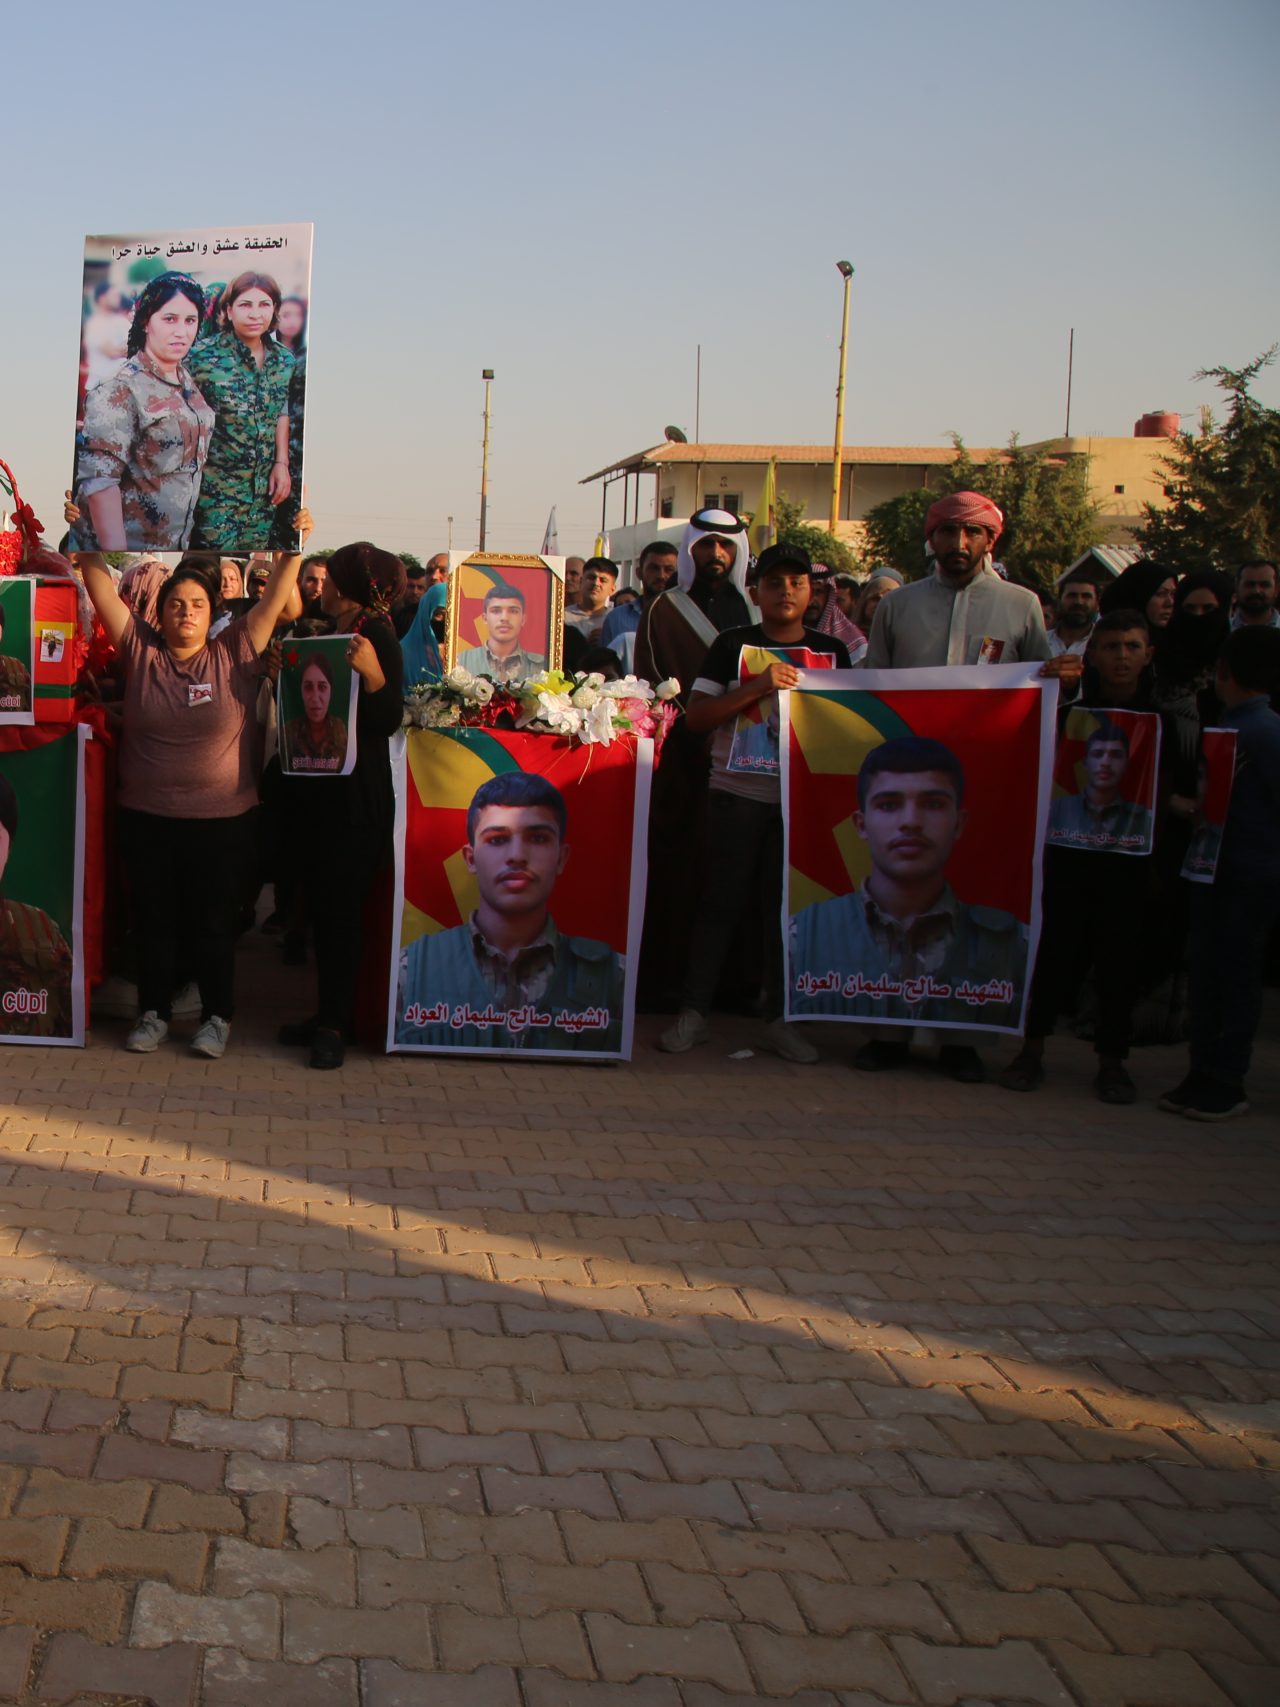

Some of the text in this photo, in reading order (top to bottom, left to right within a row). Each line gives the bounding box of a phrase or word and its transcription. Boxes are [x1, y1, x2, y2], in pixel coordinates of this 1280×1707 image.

[137, 243, 161, 259] حياة
[166, 240, 208, 258] والعشق
[213, 238, 240, 255] عشق
[244, 236, 288, 252] الحقيقة
[796, 970, 1013, 1005] الشهيد صالح سليمان العواد
[2, 987, 48, 1015] CÛDÎ
[405, 1002, 609, 1032] الشهيد صالح سليمان العواد
